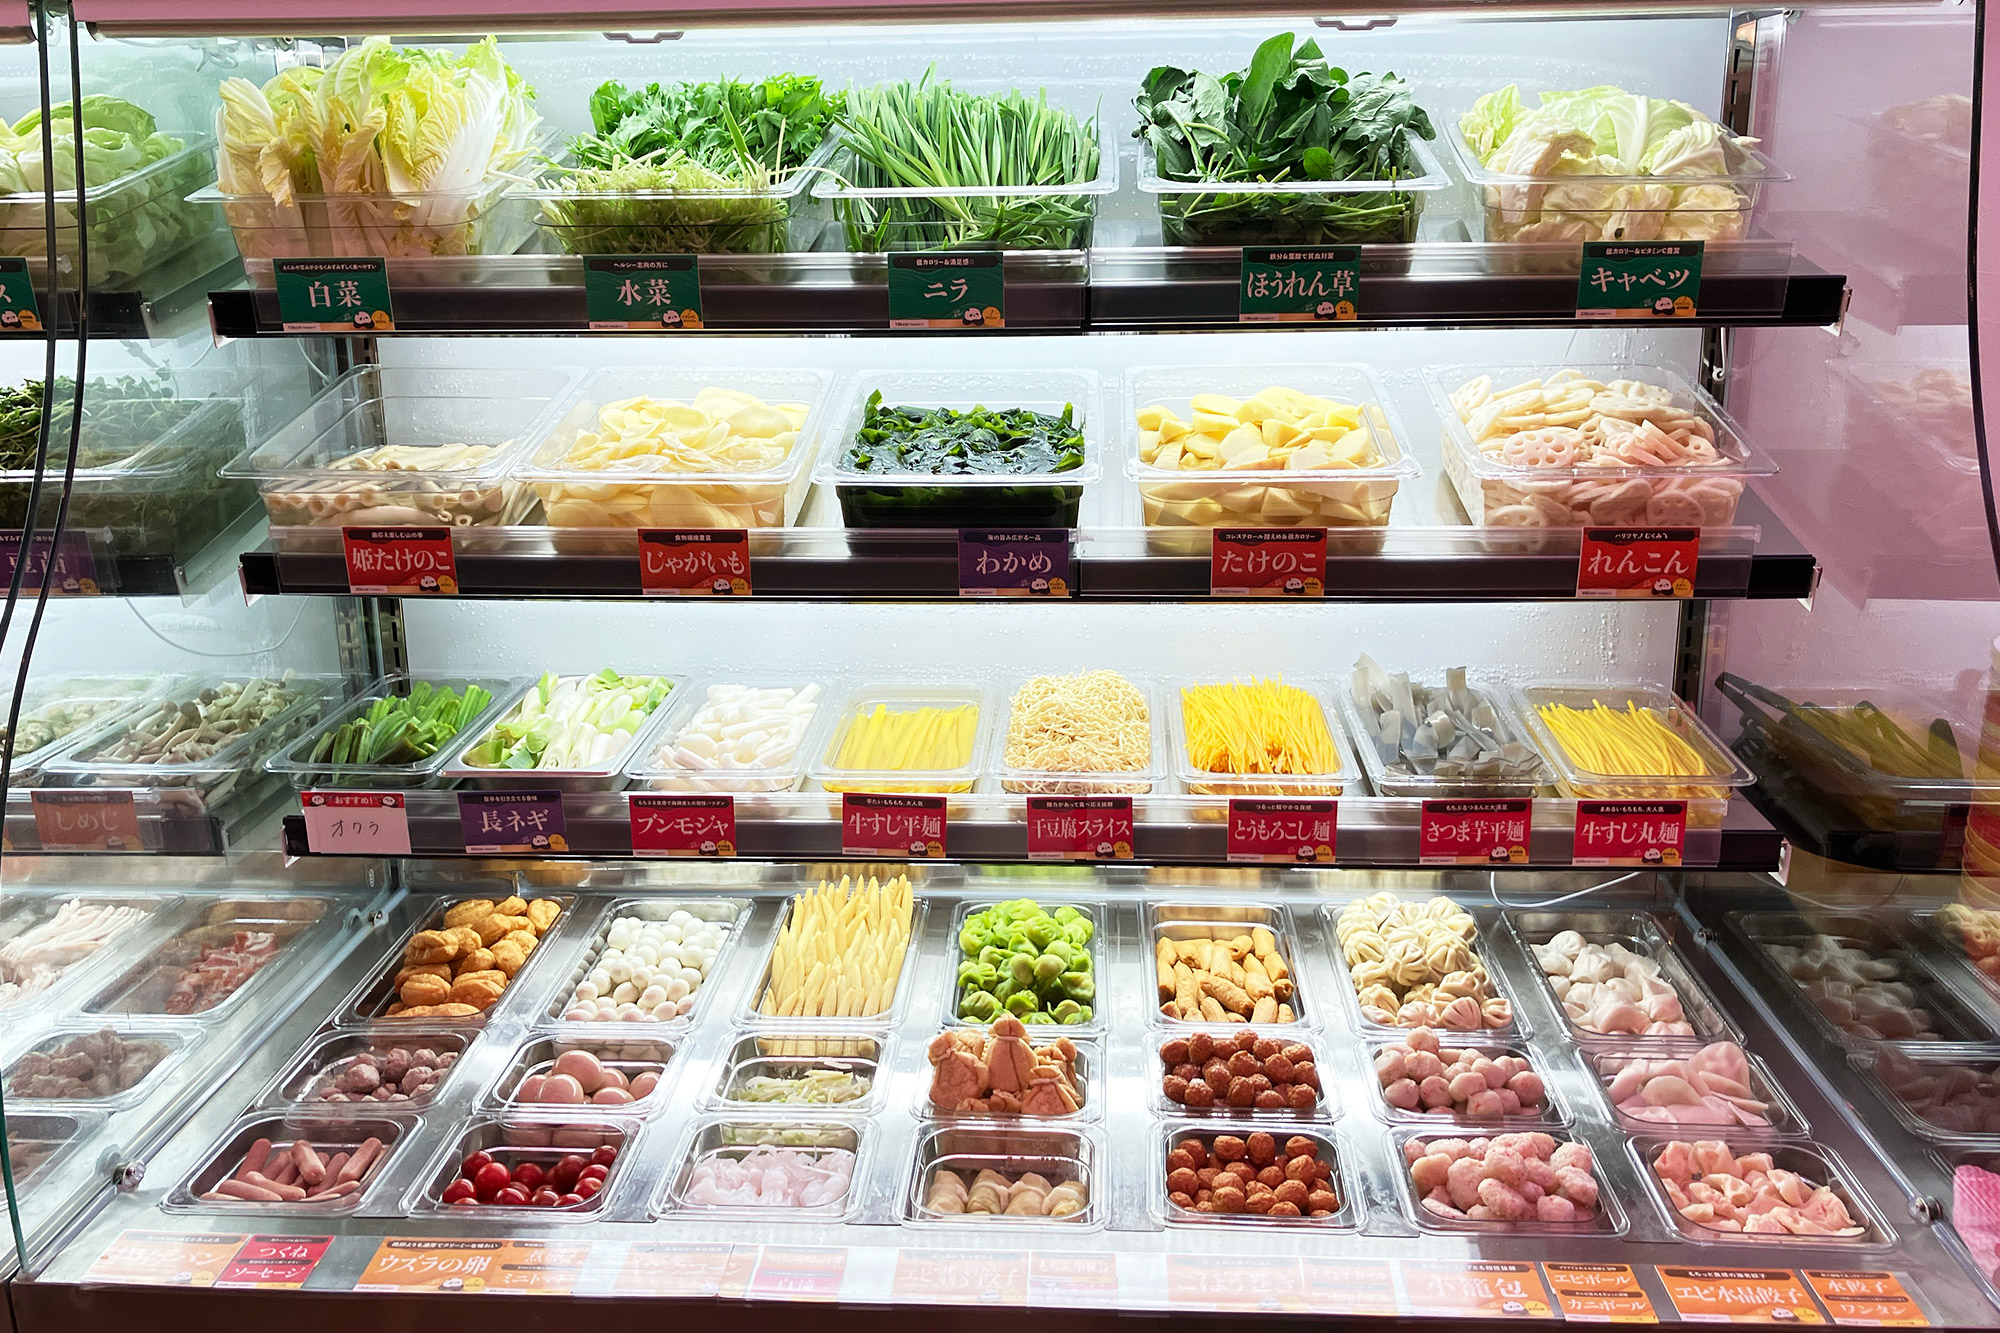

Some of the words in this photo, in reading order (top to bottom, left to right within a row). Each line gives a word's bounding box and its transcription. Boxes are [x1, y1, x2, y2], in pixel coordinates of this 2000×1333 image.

[924, 278, 968, 303] ニラ
[1247, 270, 1355, 298] ほうれん草
[1590, 267, 1690, 292] キャベツ
[308, 281, 362, 308] 白菜
[616, 279, 672, 306] 水菜
[351, 547, 451, 572] 姫たけのこ
[646, 550, 745, 575] じゃがいも
[976, 550, 1053, 575] わかめ
[1221, 550, 1318, 574] たけのこ
[1588, 548, 1689, 575] れんこん
[56, 808, 119, 831] しめじ
[331, 819, 379, 837] オクラ
[479, 809, 549, 833] 長ネギ
[637, 813, 729, 837] ブンモジャ
[848, 812, 941, 838] 牛すじ平麺
[1031, 816, 1131, 839] 干豆腐スライス
[1234, 819, 1331, 842] とうもろこし麺
[1427, 820, 1525, 842] さつま芋平麺
[1581, 821, 1680, 845] 牛すじ丸麺
[259, 1244, 309, 1258] つくね
[229, 1266, 307, 1279] ソーセージ
[375, 1253, 493, 1276] ウズラの卵
[1554, 1273, 1632, 1286] エビボール
[1829, 1279, 1890, 1293] 水餃子
[1567, 1298, 1648, 1312] カニボール
[1840, 1303, 1908, 1316] ワンタン
